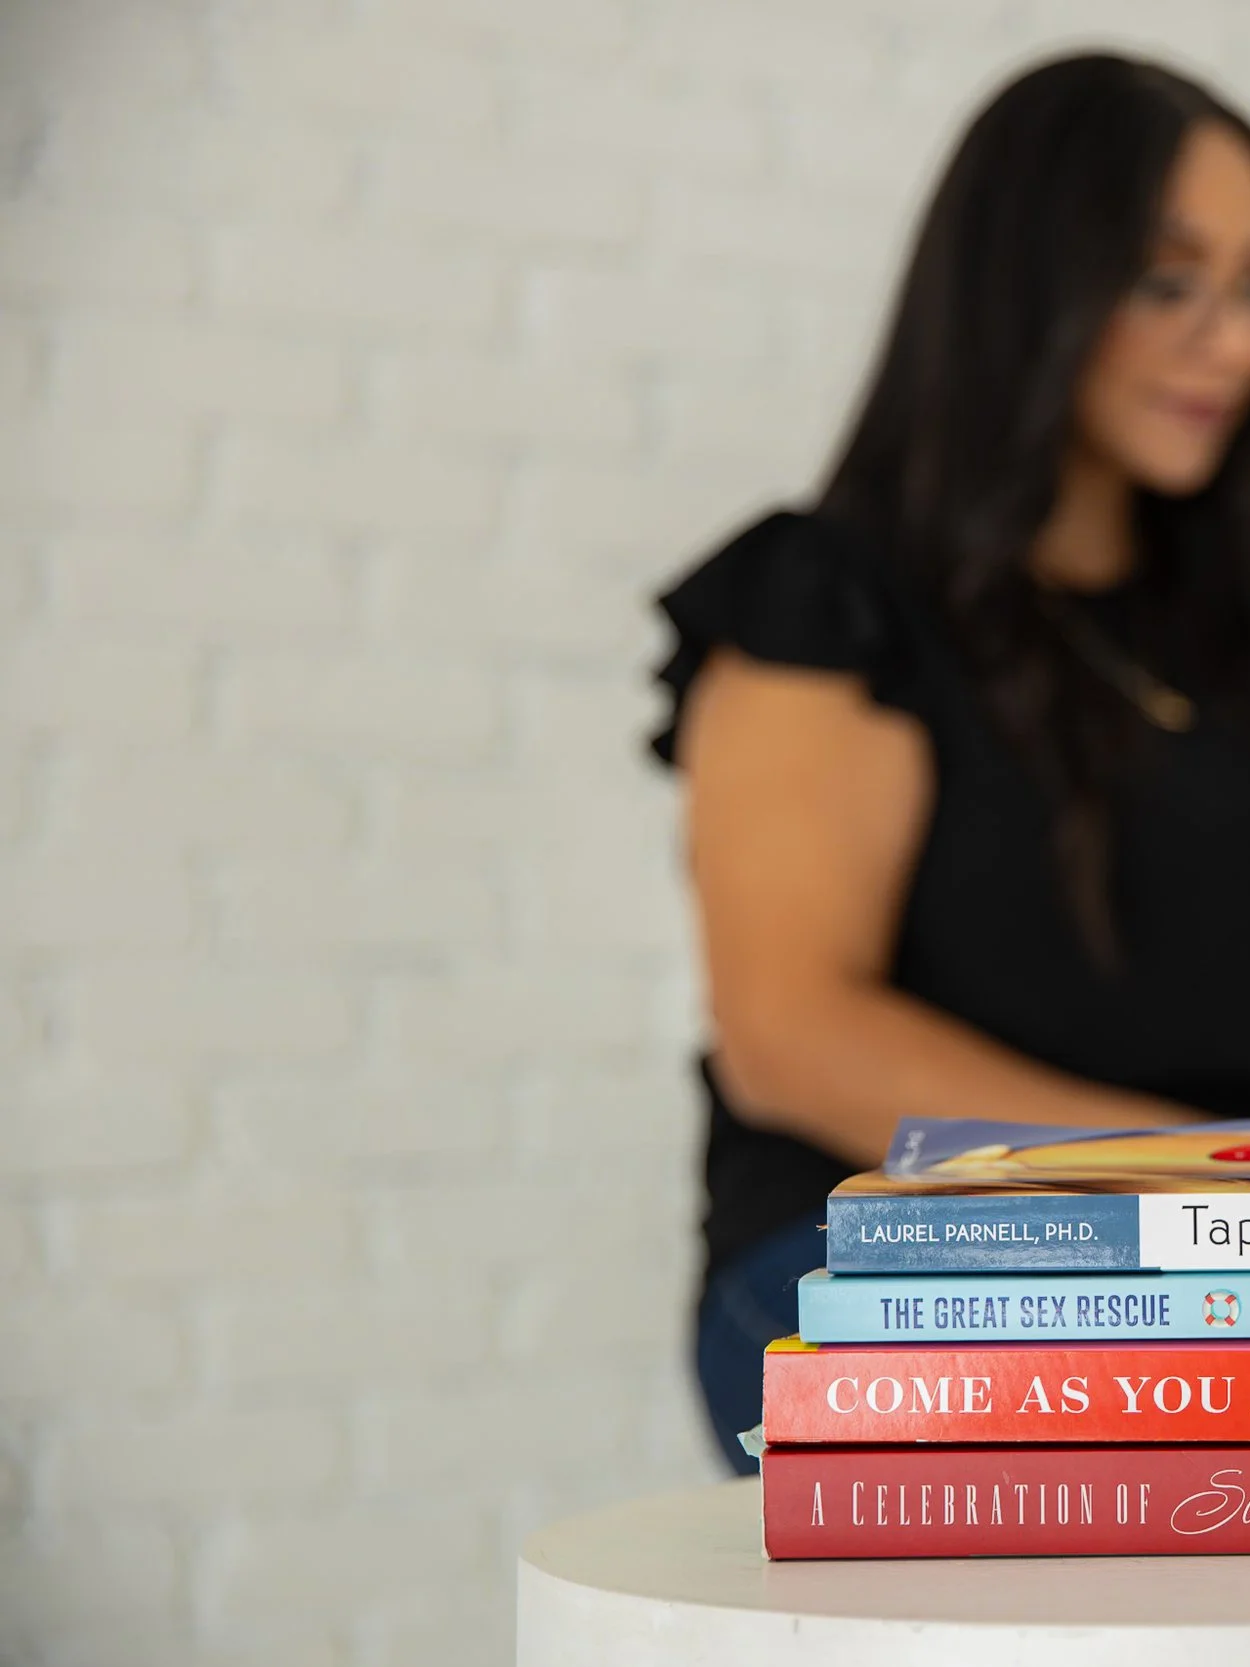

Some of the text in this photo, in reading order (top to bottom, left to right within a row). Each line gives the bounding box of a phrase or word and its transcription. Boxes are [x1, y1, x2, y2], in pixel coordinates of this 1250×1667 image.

[861, 1223, 1099, 1245] LAUREL PARNELL, PH.D.
[880, 1294, 1171, 1330] THE GREAT SEX RESCUE
[825, 1376, 993, 1415] COME
[1015, 1375, 1090, 1414] AS
[1113, 1375, 1235, 1414] YOU
[810, 1482, 825, 1526] A
[851, 1480, 1094, 1526] CELEBRATION
[1116, 1483, 1151, 1525] OF
